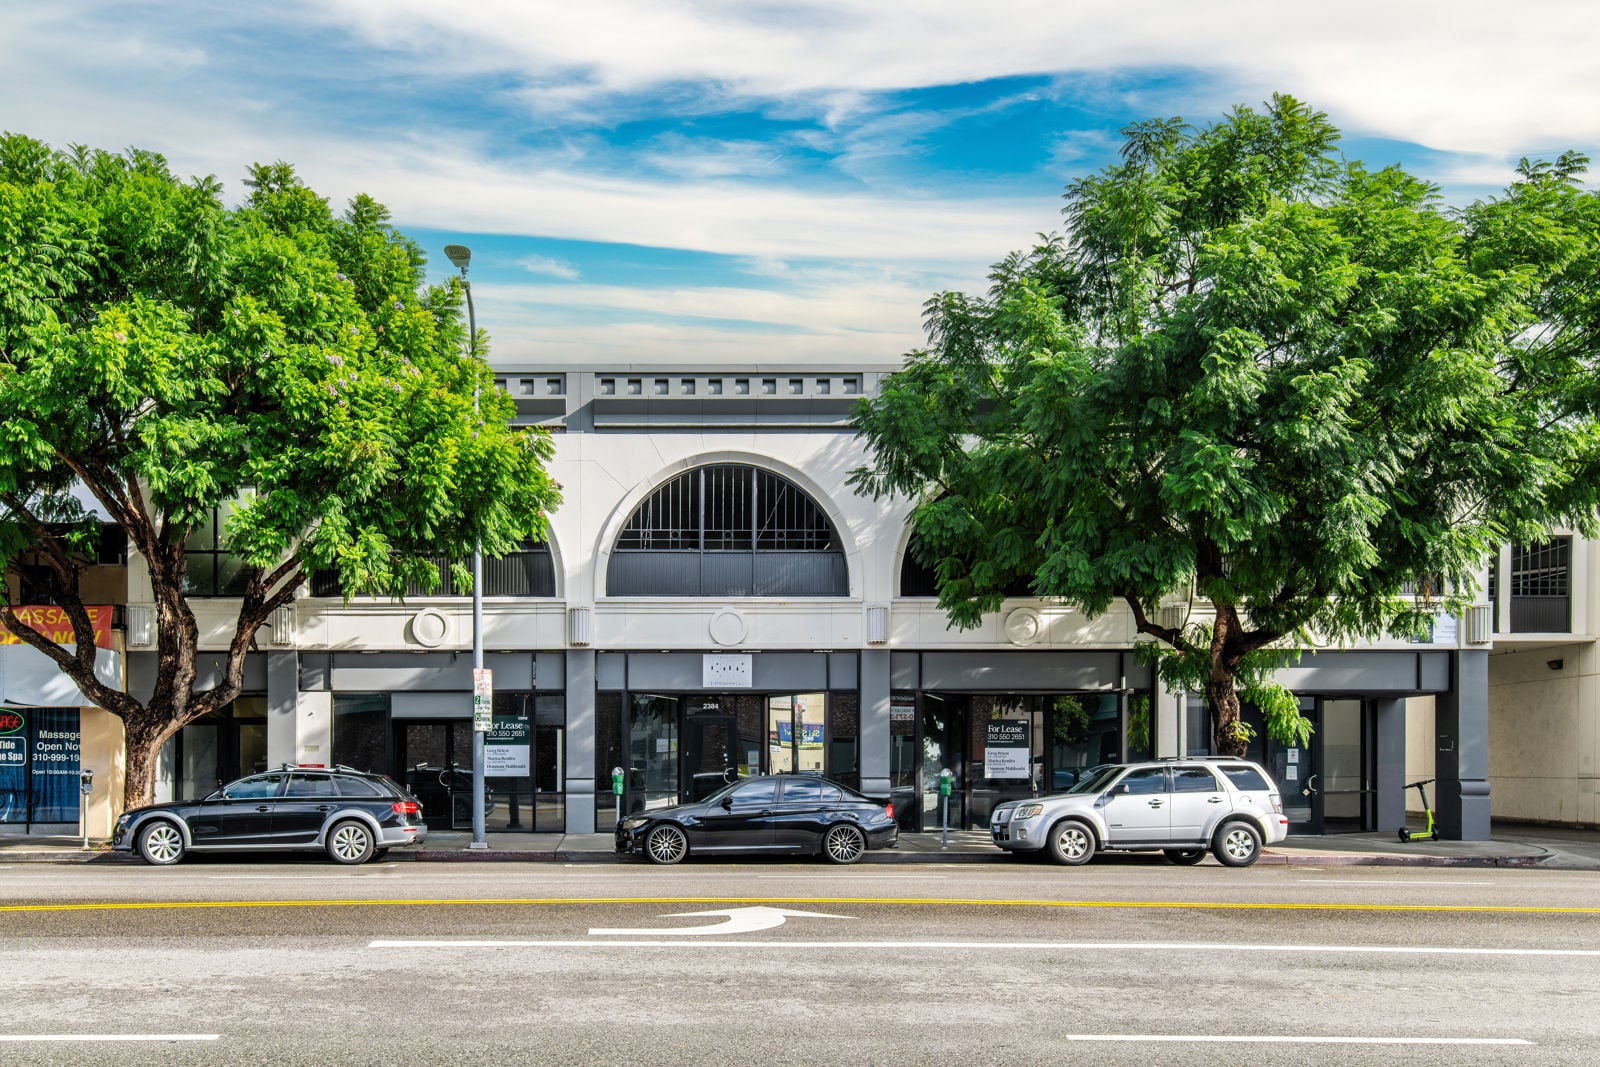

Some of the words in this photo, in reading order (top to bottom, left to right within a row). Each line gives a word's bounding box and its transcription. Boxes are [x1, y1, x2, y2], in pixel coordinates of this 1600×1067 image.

[1, 608, 99, 625] ASSAE
[0, 714, 19, 729] AGE
[500, 722, 523, 730] Lease
[39, 730, 80, 741] Massage
[36, 741, 63, 752] Open
[8, 751, 23, 761] Spa
